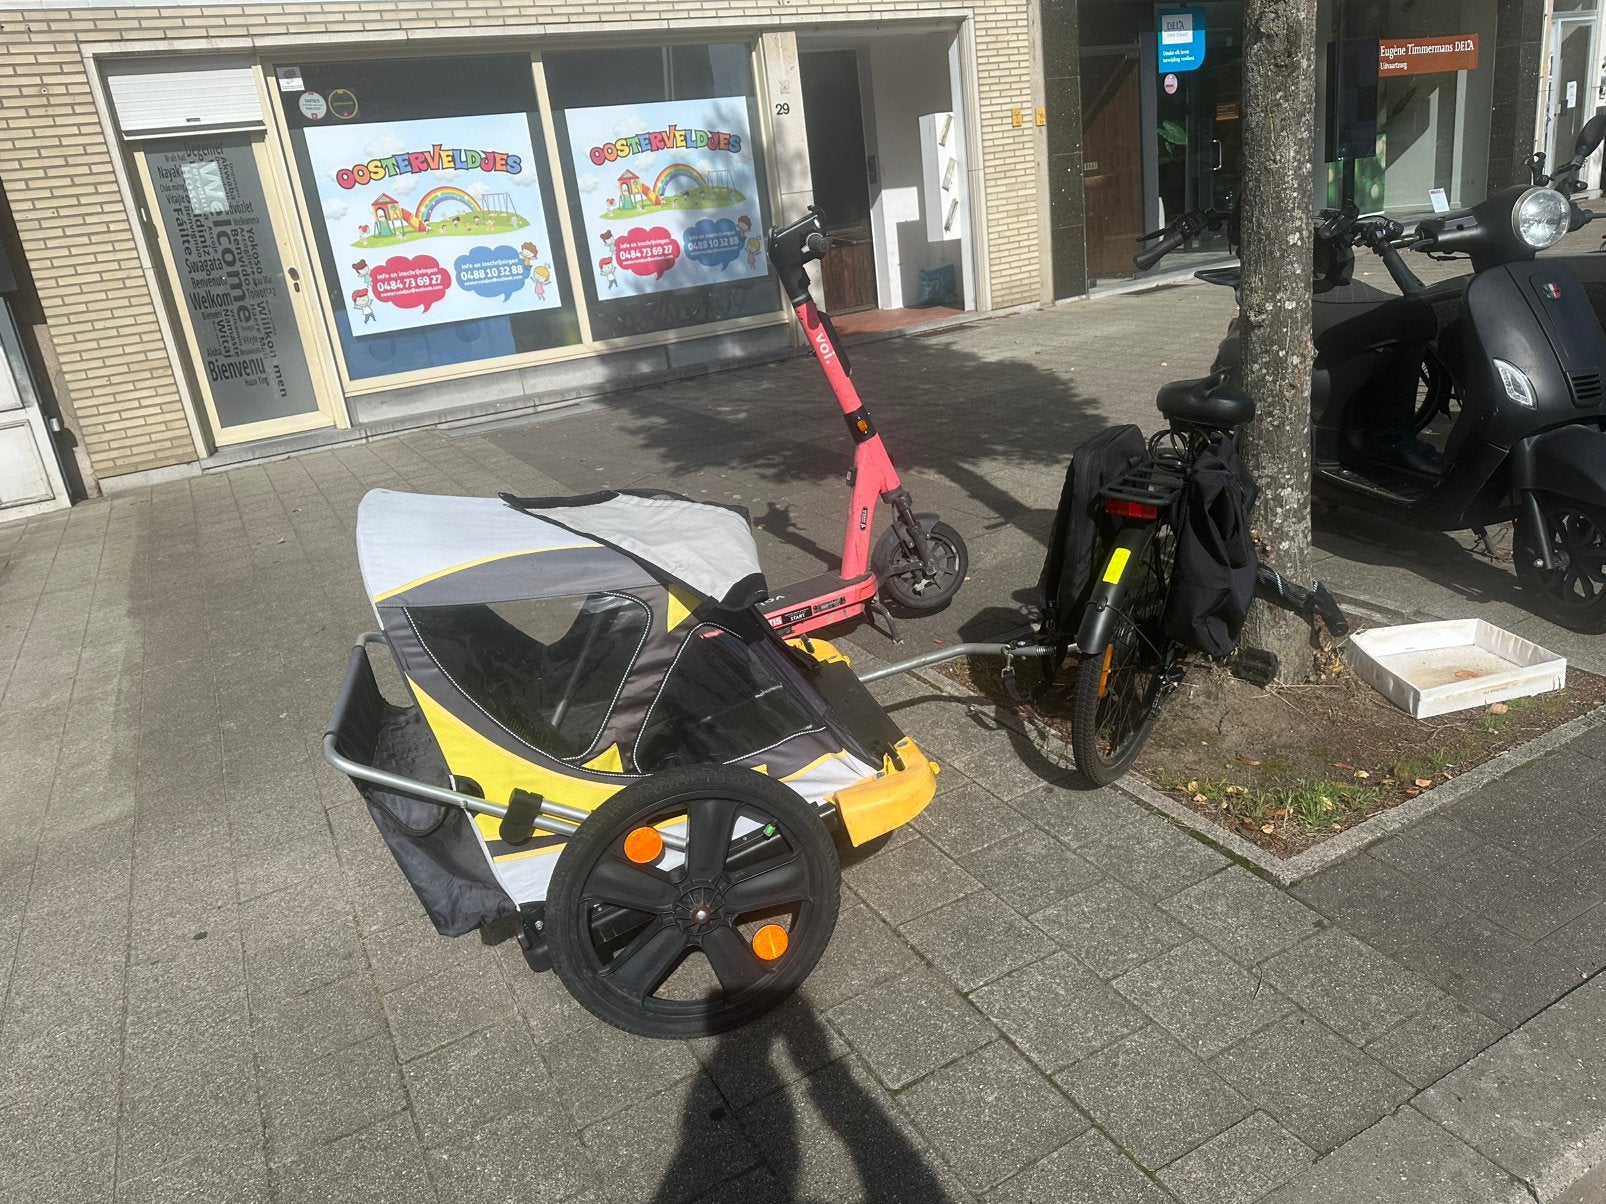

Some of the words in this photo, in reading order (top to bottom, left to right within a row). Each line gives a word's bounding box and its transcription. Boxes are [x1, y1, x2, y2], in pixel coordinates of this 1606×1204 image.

[1380, 44, 1406, 60] Eugène
[1407, 43, 1454, 55] Timmermans
[775, 102, 790, 115] 29
[589, 124, 742, 166] OOSTERVELDJES
[336, 144, 522, 190] OOSTERVELDJES
[619, 249, 642, 260] 0484
[642, 247, 652, 257] 73
[652, 246, 663, 255] 69
[664, 244, 673, 254] 27
[377, 279, 403, 292] 0484
[403, 278, 416, 288] 73
[417, 276, 430, 286] 69
[430, 274, 442, 285] 27
[461, 269, 486, 281] 0488
[486, 268, 498, 277] 10
[499, 266, 511, 276] 32
[511, 265, 523, 275] 88
[189, 289, 234, 311] Welkom
[216, 319, 232, 358] Witaj
[208, 357, 266, 382] Bienvenu
